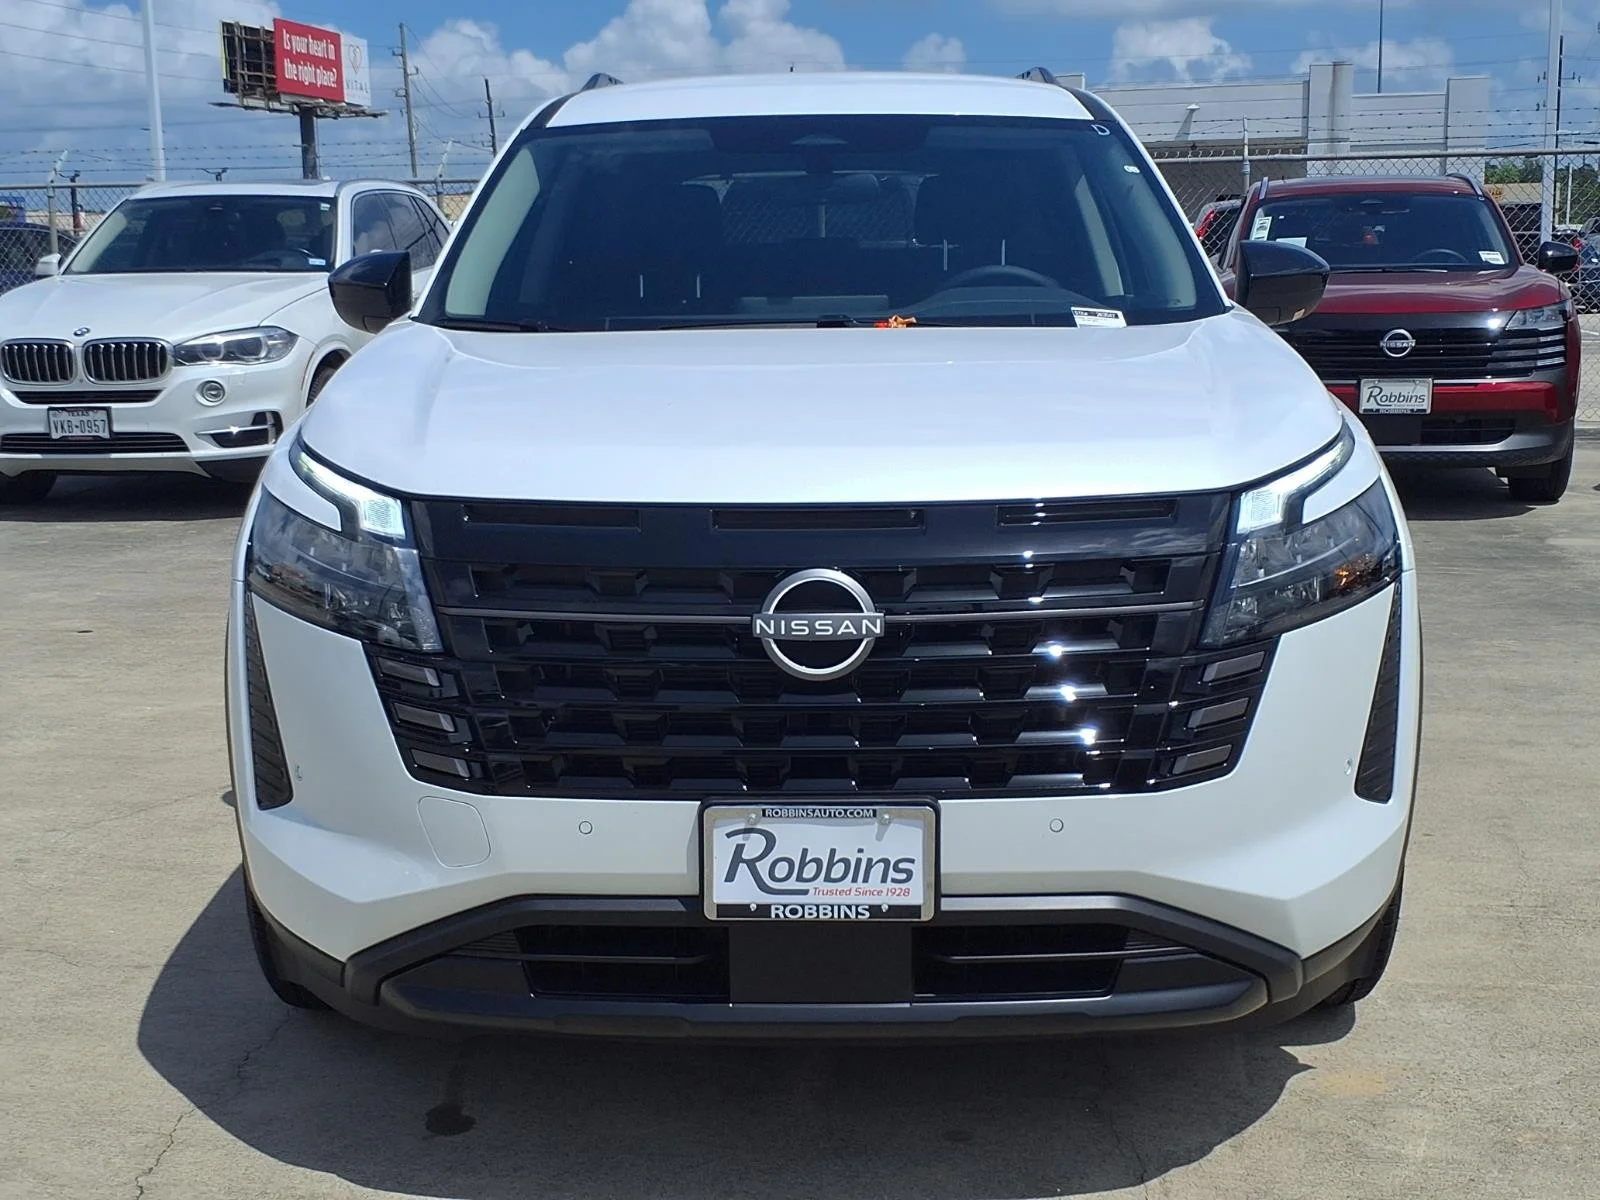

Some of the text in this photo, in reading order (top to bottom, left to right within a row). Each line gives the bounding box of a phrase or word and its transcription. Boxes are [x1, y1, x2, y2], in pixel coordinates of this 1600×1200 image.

[283, 28, 335, 60] Is your heart in
[284, 58, 337, 88] the right place?
[1367, 386, 1425, 406] Robbins
[755, 618, 881, 635] NISSAN
[765, 808, 874, 818] ROBBINSAUTO.COM
[724, 828, 915, 895] Robbins
[813, 887, 911, 897] Trusted Since 1928
[770, 904, 871, 919] ROBBINS
